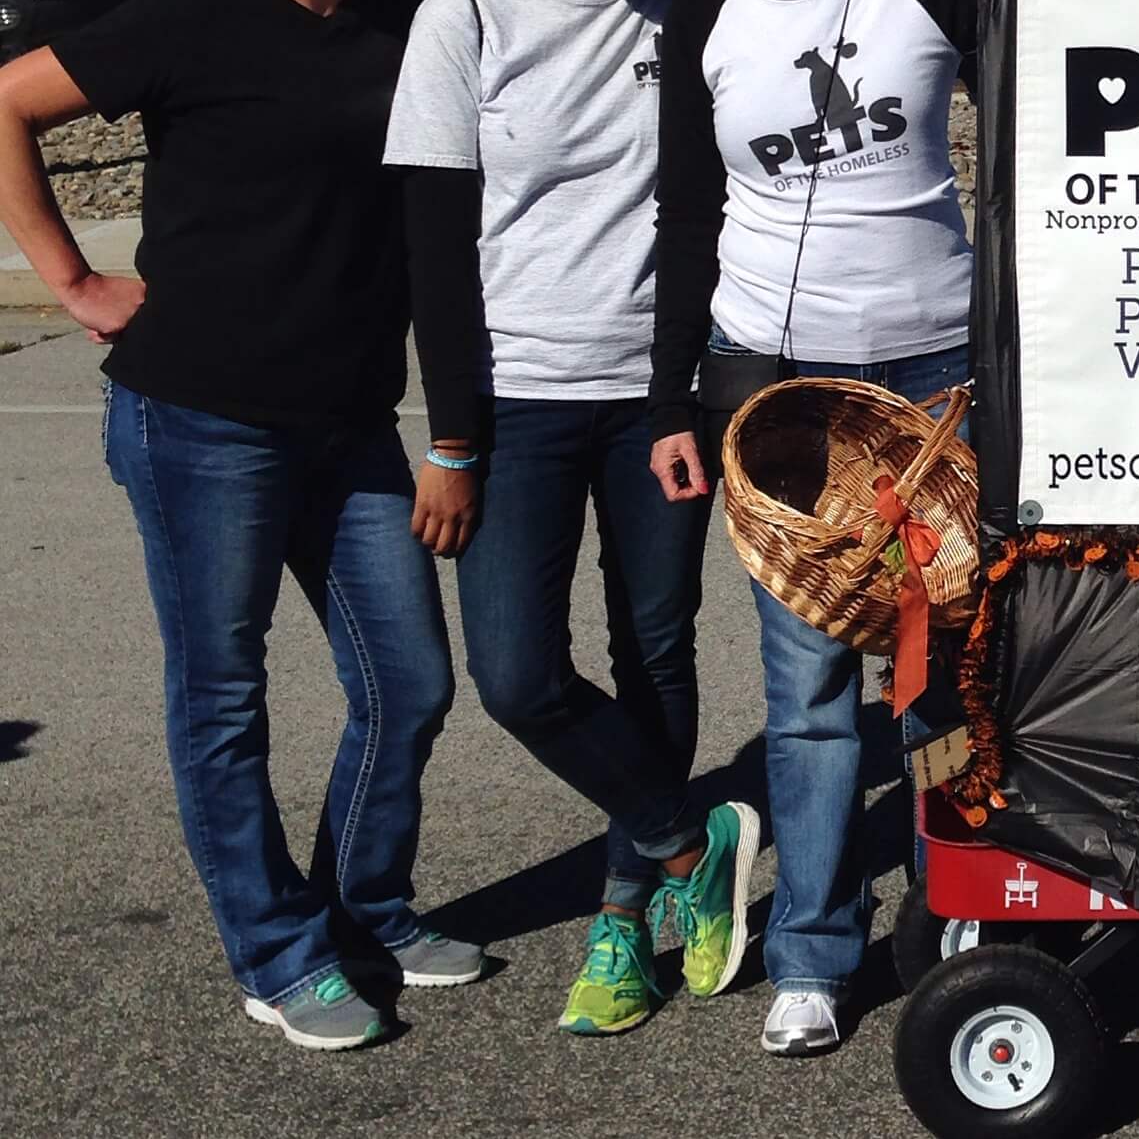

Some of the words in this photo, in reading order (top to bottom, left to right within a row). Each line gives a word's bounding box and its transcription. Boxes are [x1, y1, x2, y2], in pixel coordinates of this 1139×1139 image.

[633, 61, 661, 81] PE
[748, 96, 908, 177] PETS
[774, 177, 796, 193] OF
[794, 168, 827, 188] THE
[827, 142, 911, 178] HOMELESS
[1065, 173, 1118, 205] OF
